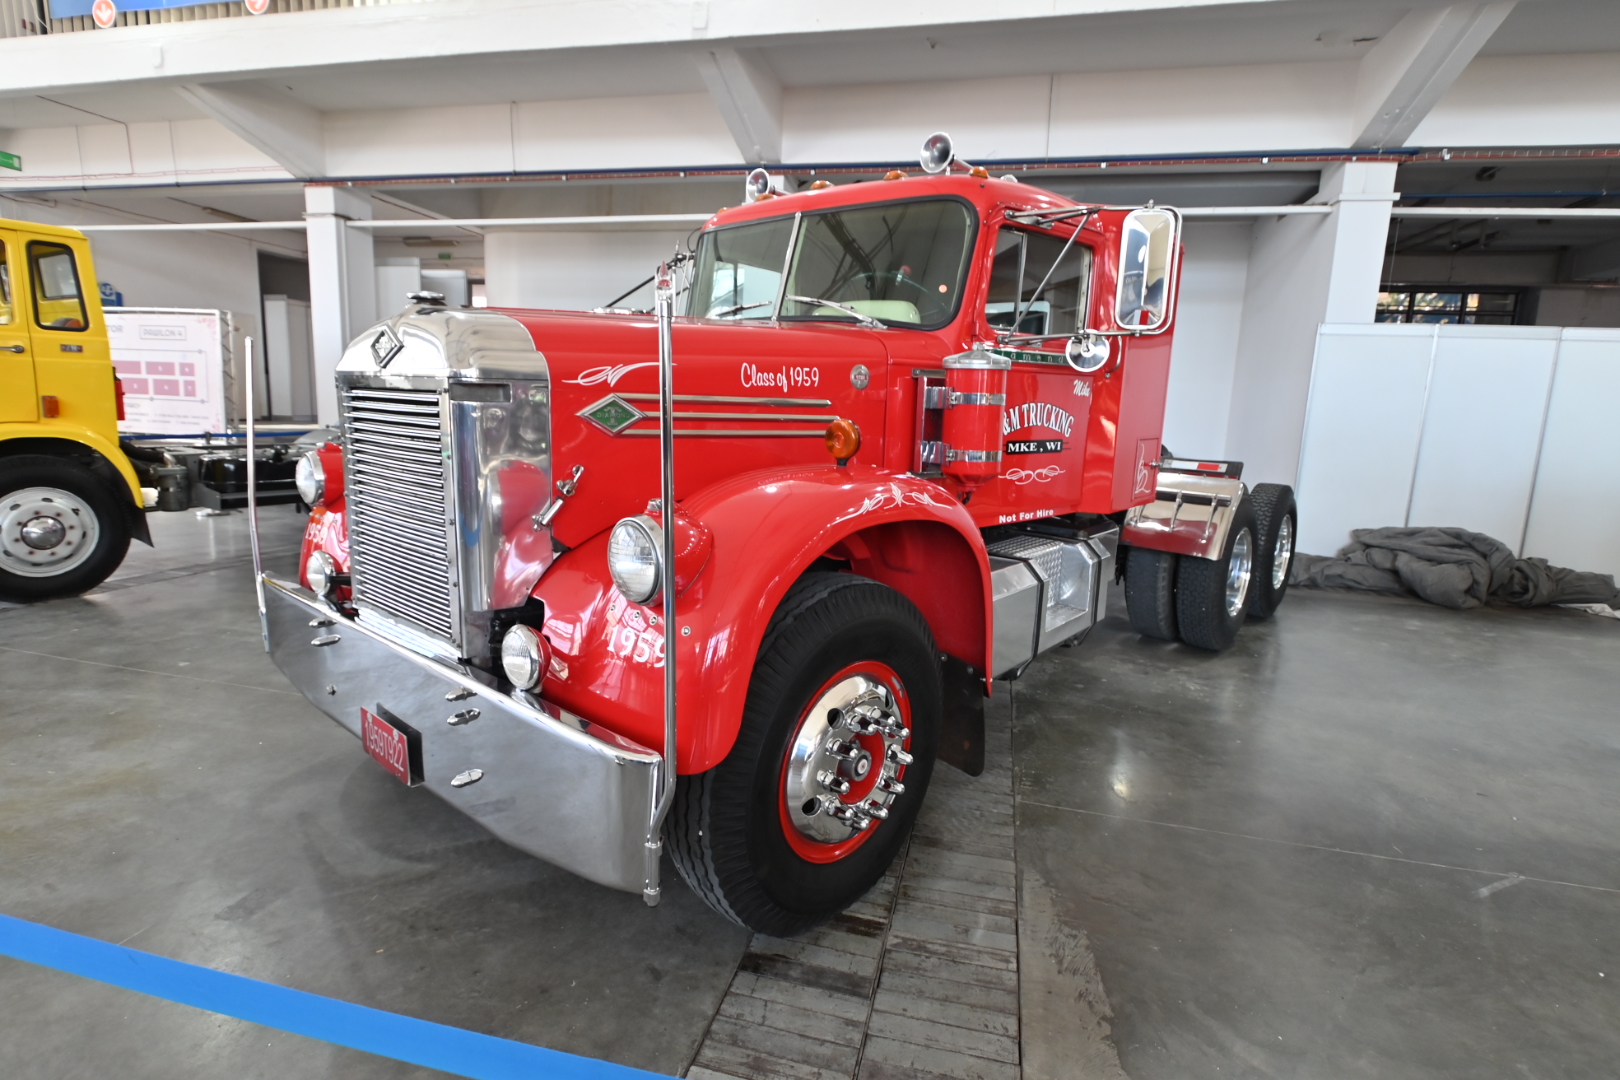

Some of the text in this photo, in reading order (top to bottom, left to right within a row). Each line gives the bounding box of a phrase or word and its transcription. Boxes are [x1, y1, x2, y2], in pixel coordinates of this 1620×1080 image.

[740, 362, 820, 393] Class of 1959
[1073, 379, 1091, 396] Mike
[1021, 402, 1075, 438] TRUCKING
[1046, 441, 1062, 451] WI
[998, 509, 1054, 524] Not For Hire
[606, 624, 666, 668] 1959
[364, 719, 405, 772] 1959T922
